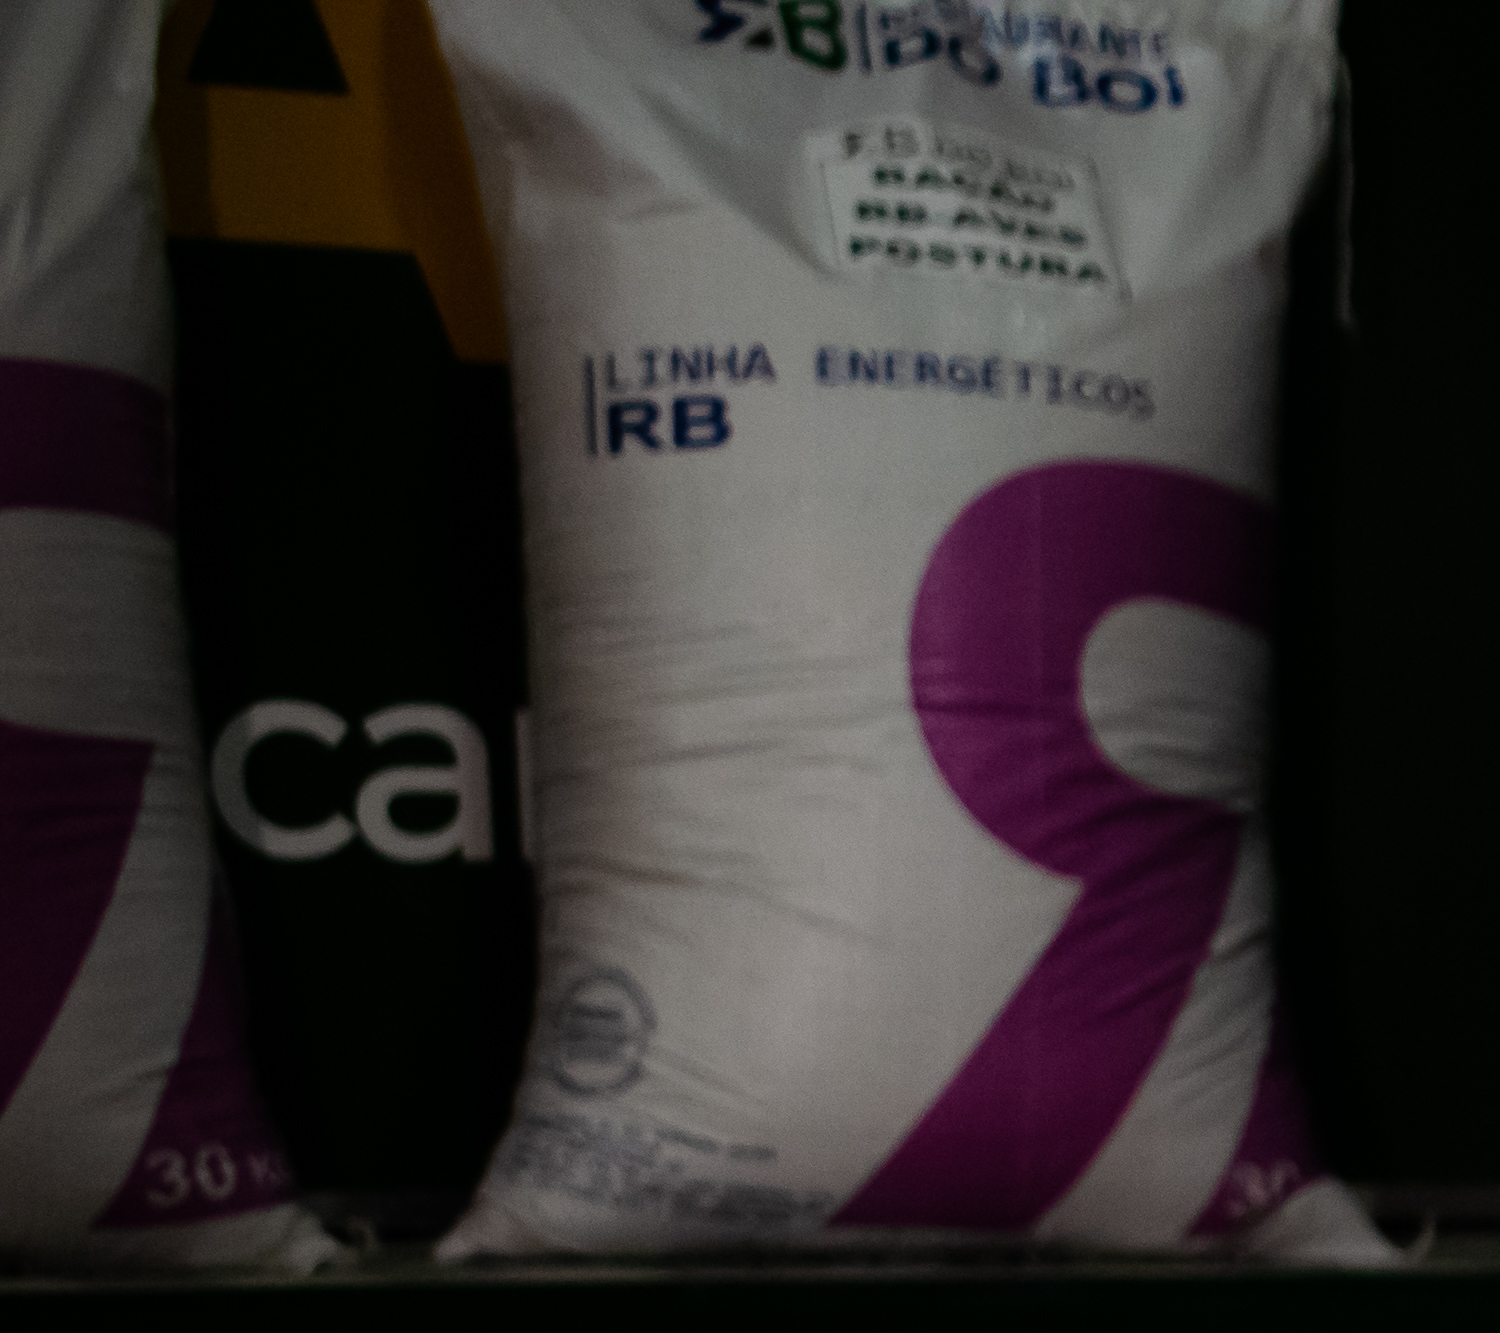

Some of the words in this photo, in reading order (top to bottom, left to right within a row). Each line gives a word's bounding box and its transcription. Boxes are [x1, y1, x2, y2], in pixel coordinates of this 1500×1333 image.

[605, 343, 775, 394] LINHA
[606, 396, 731, 454] RB
[143, 1142, 239, 1209] 30
